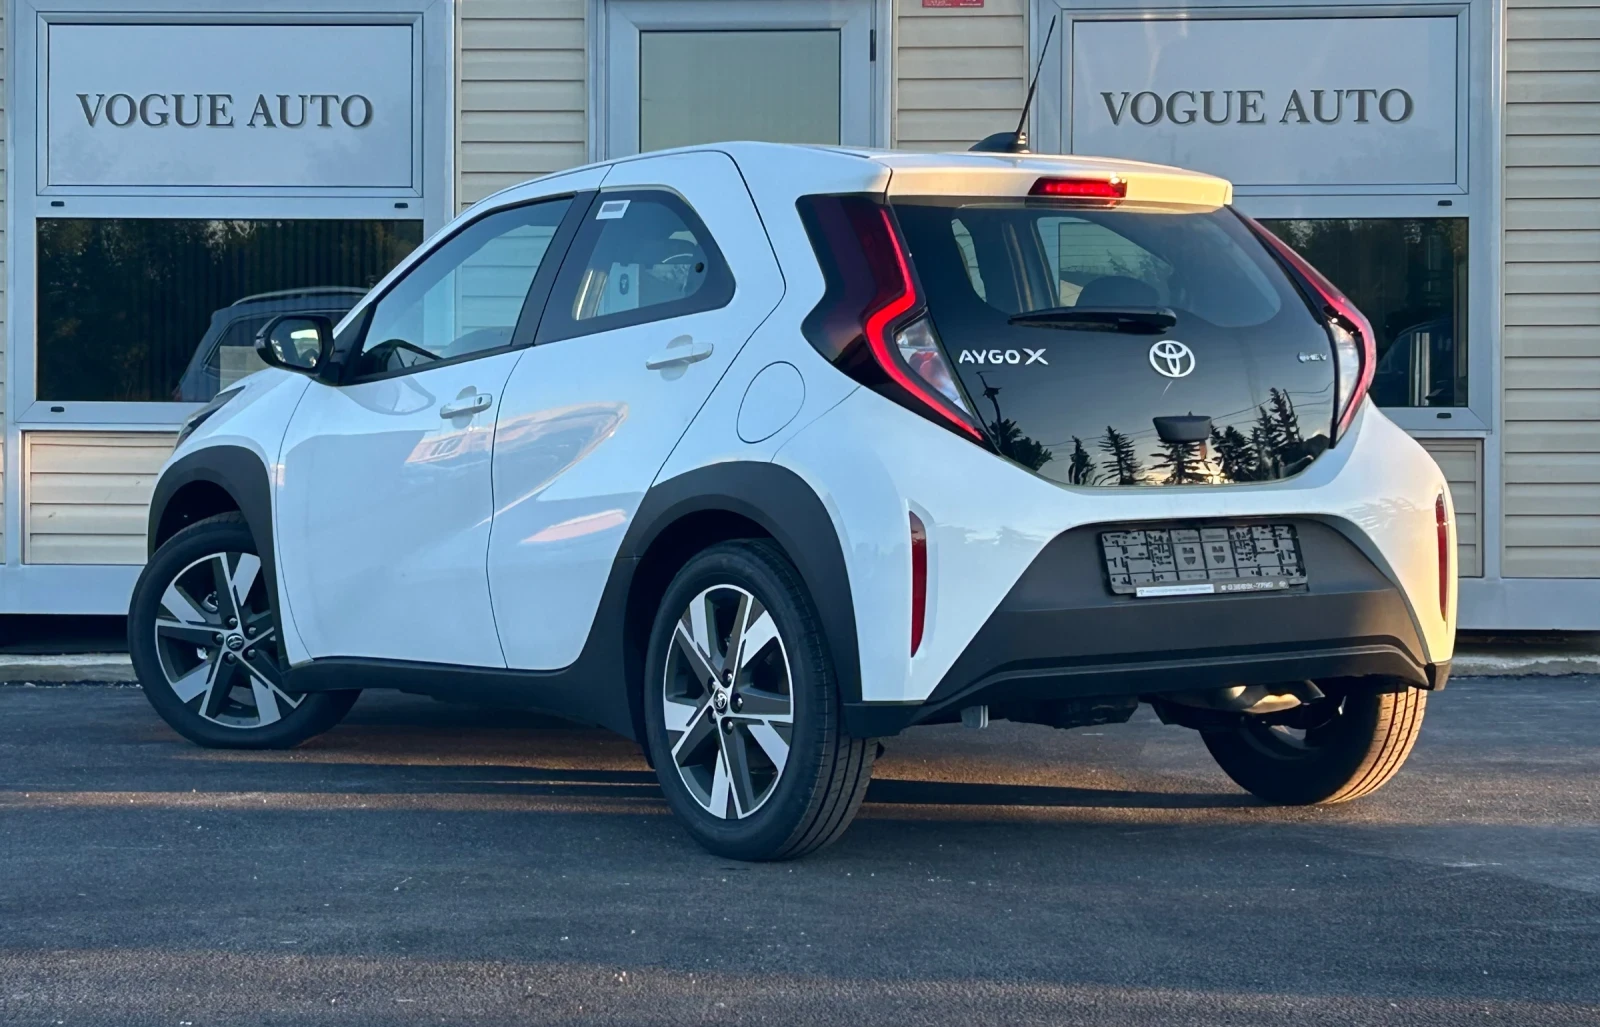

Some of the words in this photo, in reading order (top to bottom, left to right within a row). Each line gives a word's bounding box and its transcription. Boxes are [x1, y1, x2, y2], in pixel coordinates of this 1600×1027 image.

[76, 93, 235, 128] VOGUE
[246, 93, 374, 128] AUTO
[1100, 90, 1267, 126] VOGUE
[1278, 88, 1415, 124] AUTO
[958, 349, 1021, 364] AYGO
[1021, 347, 1049, 366] X
